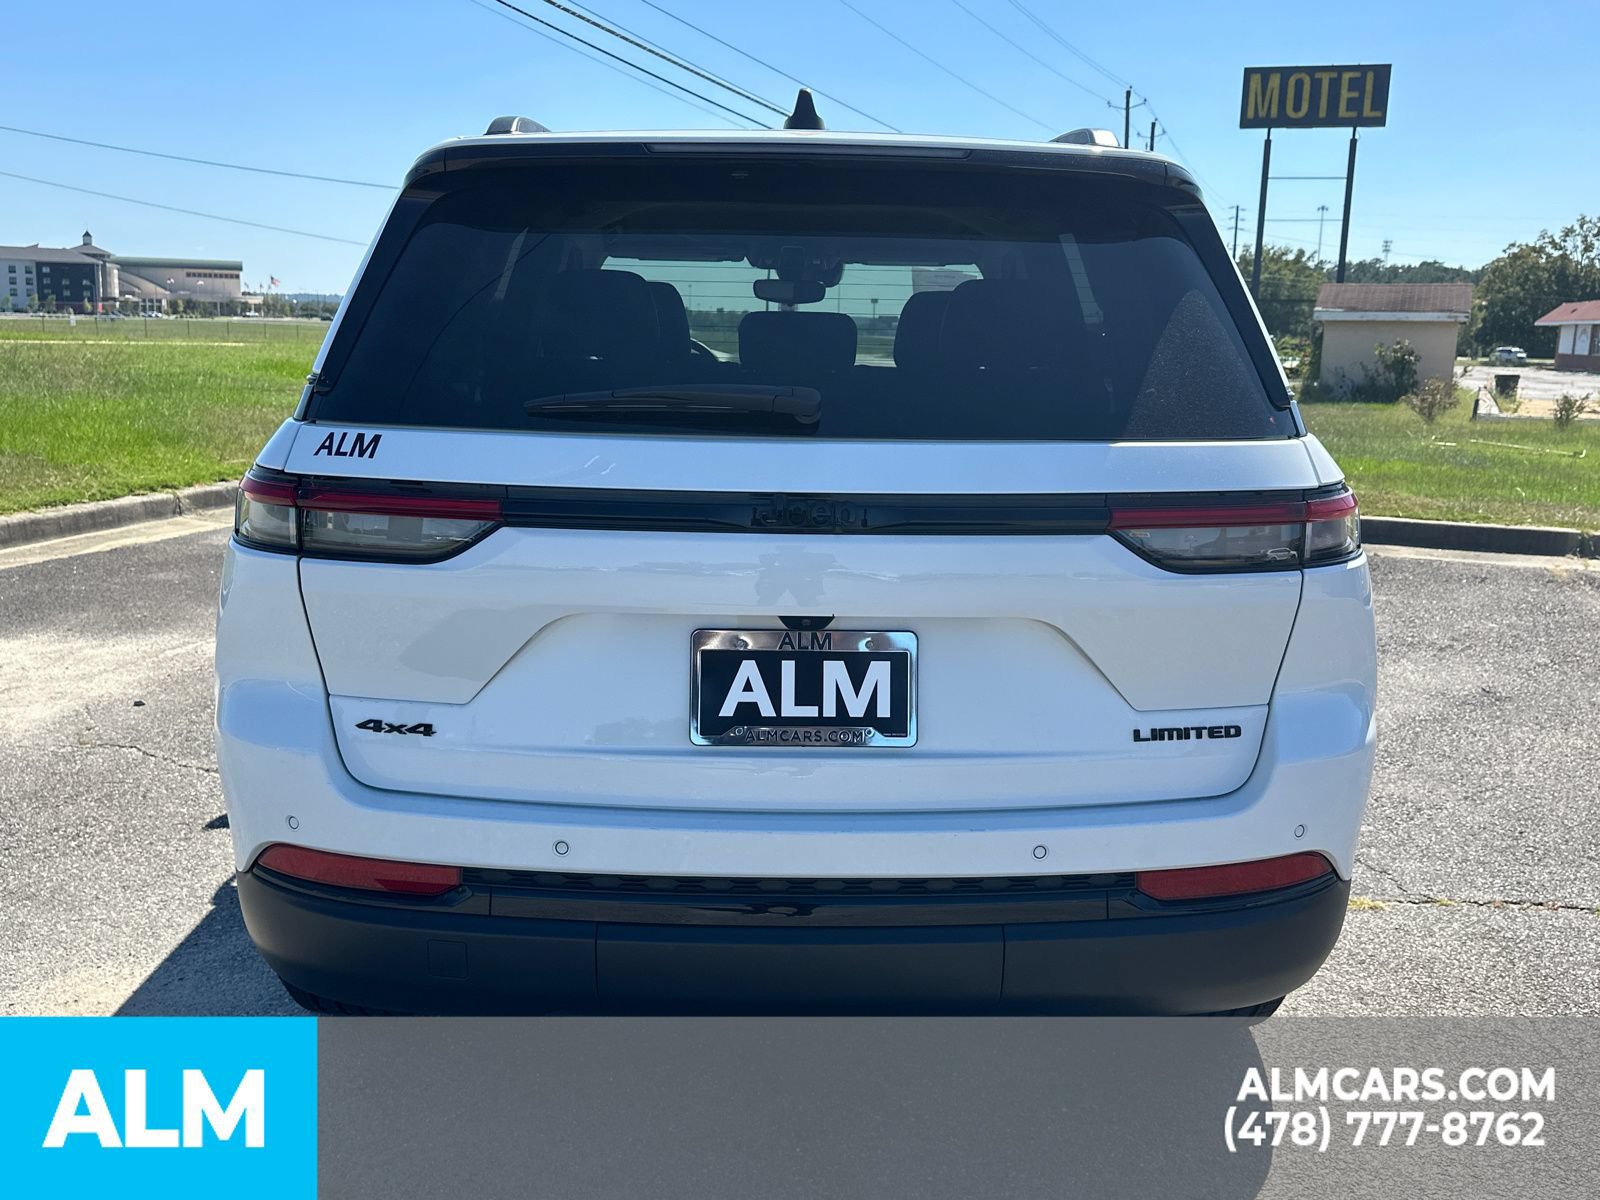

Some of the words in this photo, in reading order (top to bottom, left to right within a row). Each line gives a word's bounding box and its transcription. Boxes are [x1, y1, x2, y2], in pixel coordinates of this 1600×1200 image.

[1247, 71, 1382, 119] MOTEL
[313, 431, 382, 459] ALM
[778, 632, 832, 650] ALM
[718, 660, 891, 718] ALM
[355, 719, 437, 737] 4x4
[745, 730, 865, 743] ALMCARS.COM
[1133, 725, 1242, 742] LIMITED
